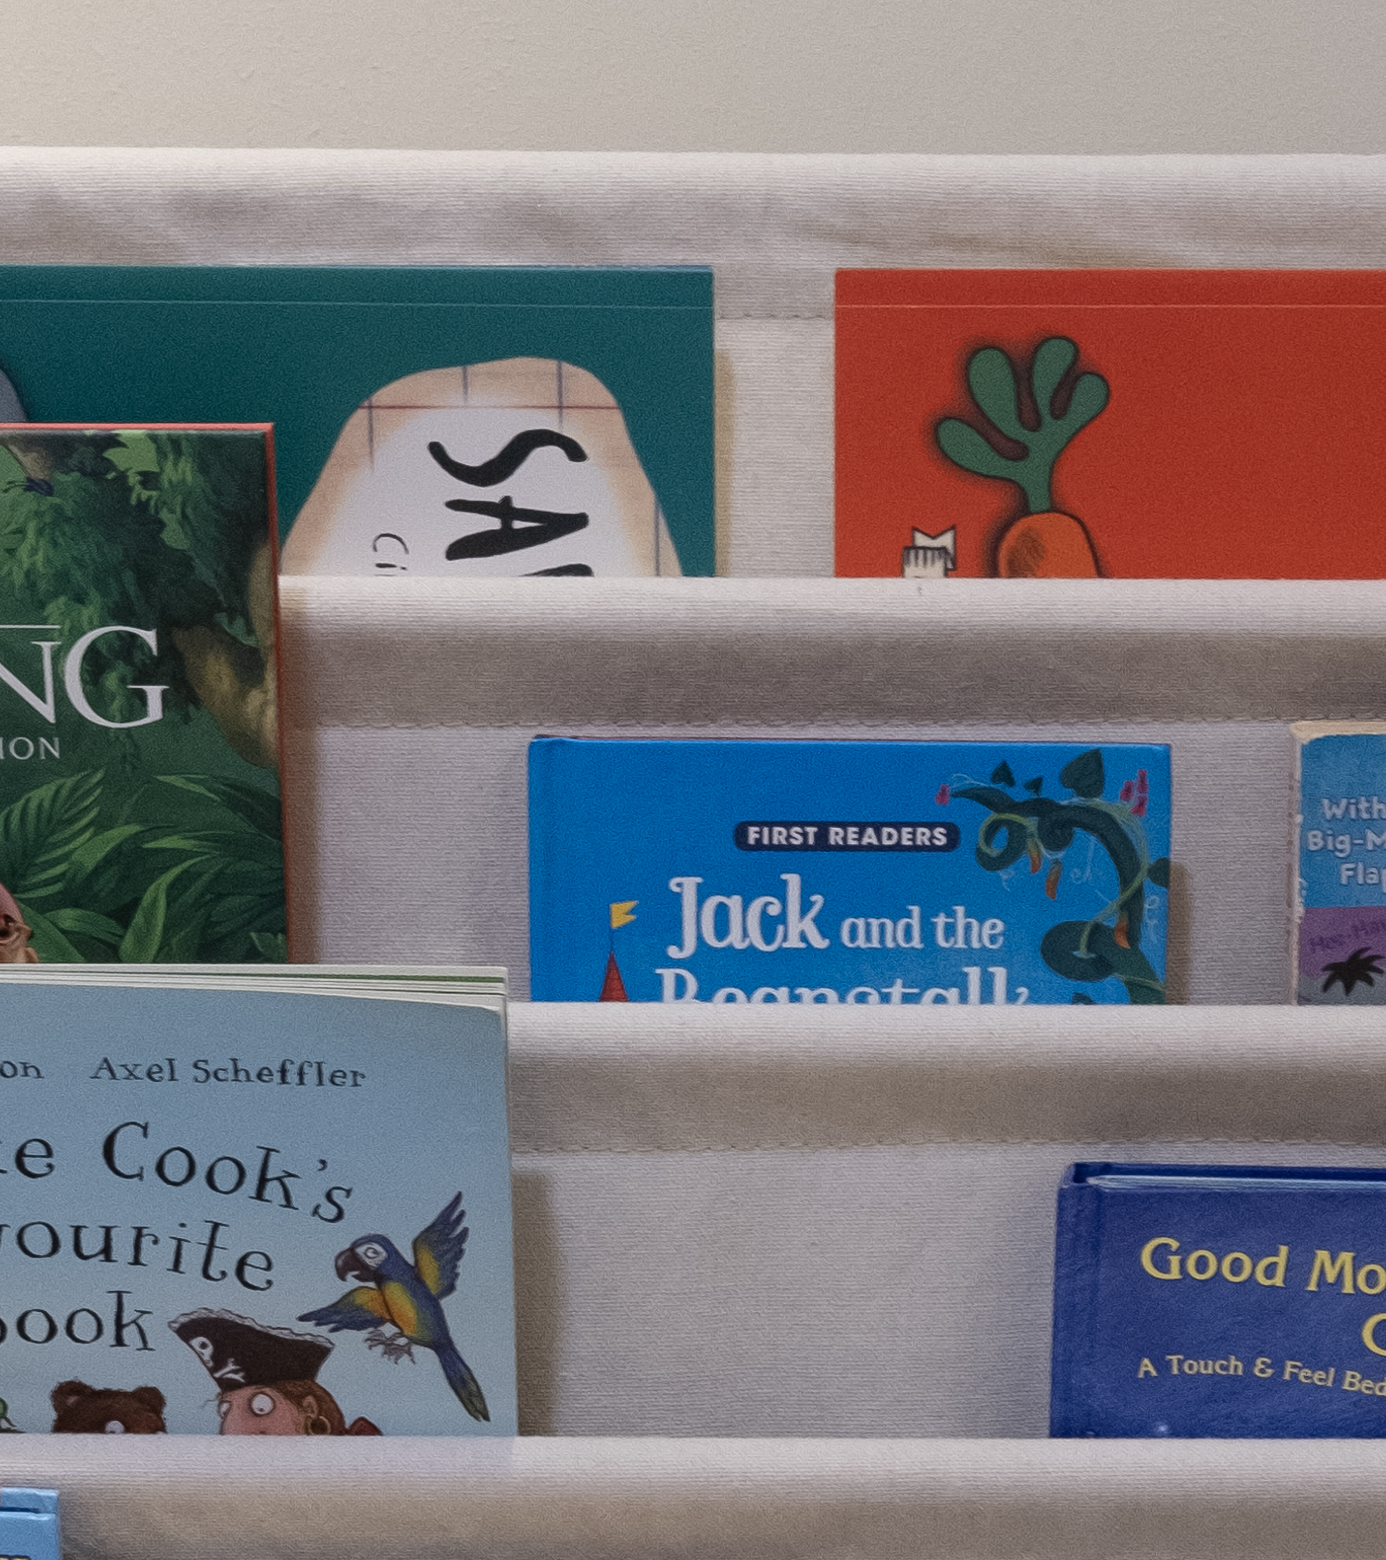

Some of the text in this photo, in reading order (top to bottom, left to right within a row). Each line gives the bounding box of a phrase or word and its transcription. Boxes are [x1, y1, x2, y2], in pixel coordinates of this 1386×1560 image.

[372, 533, 409, 576] Ci
[747, 827, 948, 847] FIRST READERS
[667, 874, 1004, 959] Jack and the
[90, 1056, 179, 1084] Axel
[192, 1057, 367, 1089] Scheffler
[102, 1120, 354, 1224] Cook's
[1140, 1236, 1288, 1288] Good
[1138, 1357, 1158, 1379] A
[1166, 1354, 1244, 1378] Touch
[1253, 1356, 1276, 1378] &
[1283, 1361, 1335, 1387] Feel
